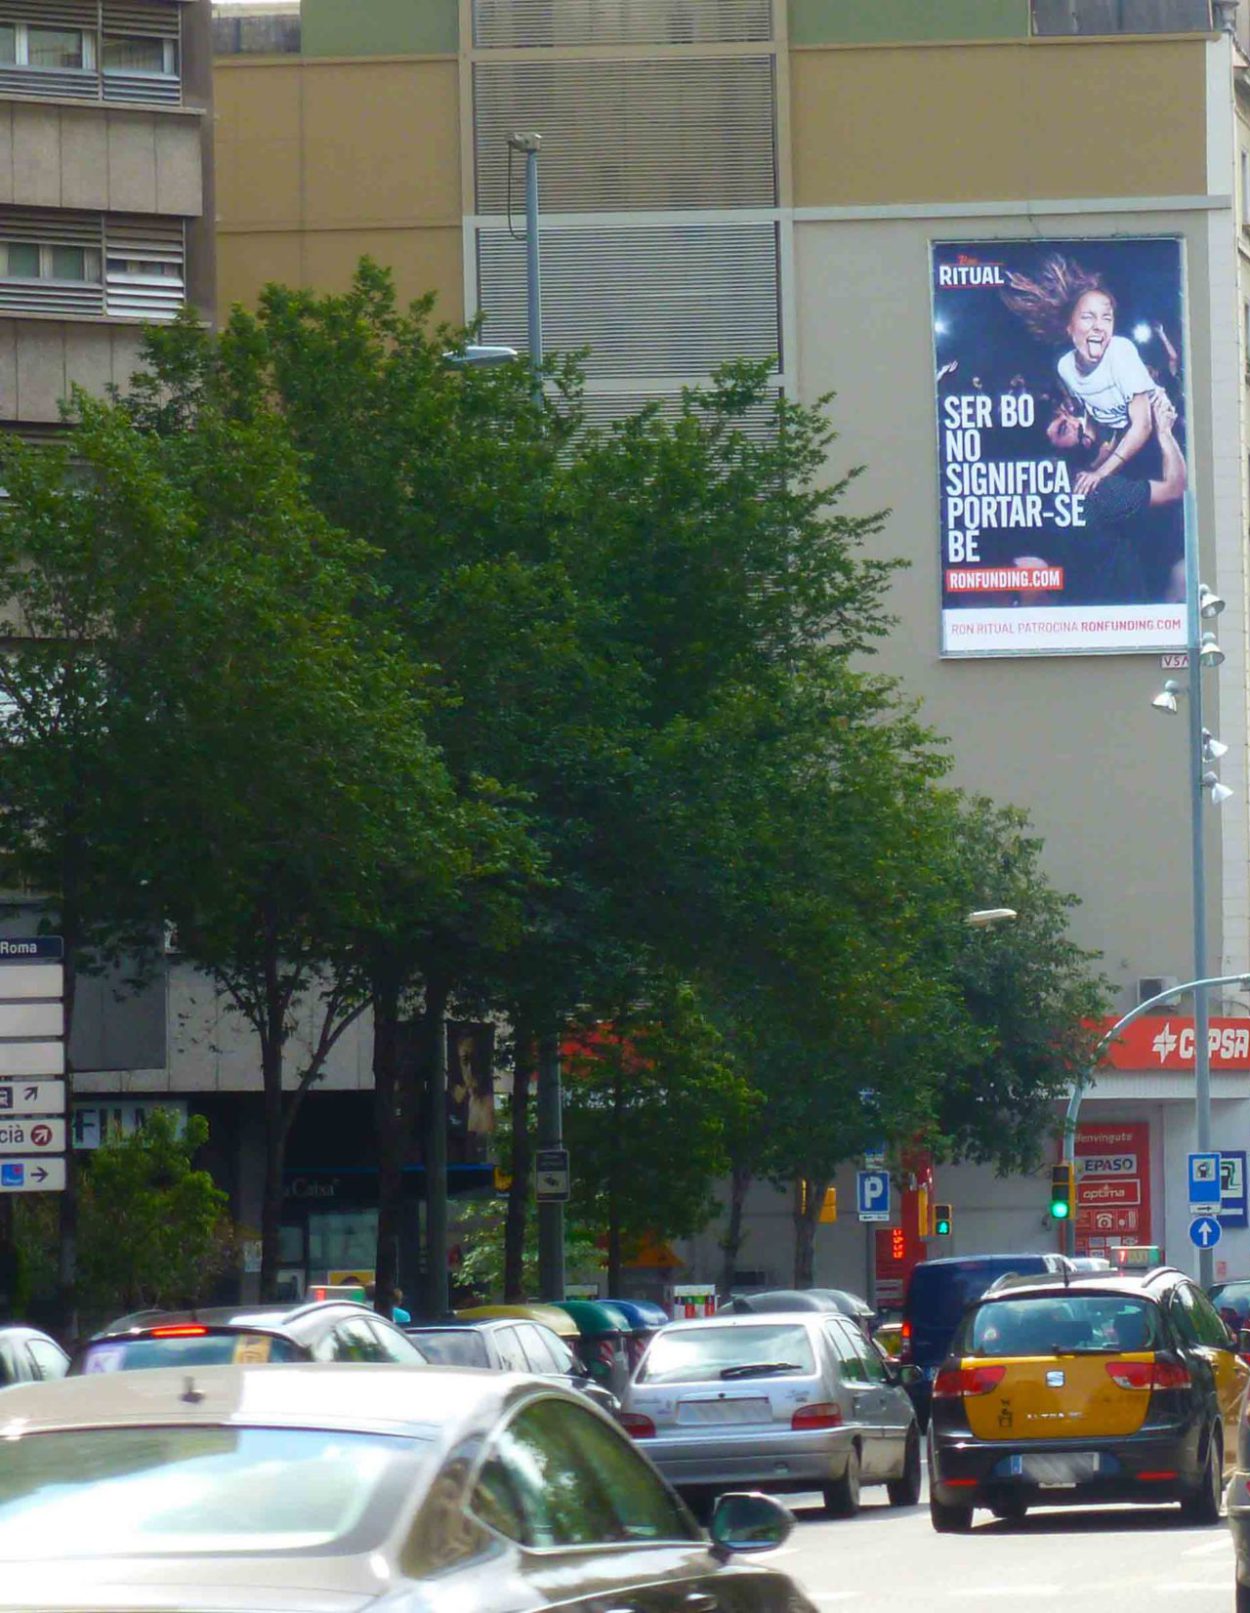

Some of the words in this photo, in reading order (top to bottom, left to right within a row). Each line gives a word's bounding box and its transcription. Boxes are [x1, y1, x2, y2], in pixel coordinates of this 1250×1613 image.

[939, 265, 1005, 286] RITUAL
[944, 395, 993, 429] SER
[1000, 393, 1035, 428] BO
[945, 429, 981, 462] NO
[945, 460, 1071, 496] SIGNIFICA
[947, 494, 1086, 530] PORTAR-SE
[950, 570, 1060, 589] RONFUNDING.COM
[951, 624, 974, 635] RON
[976, 622, 1014, 634] RITUAL
[1017, 621, 1078, 633] PATROCINA
[1081, 619, 1181, 632] RONFUNDING.COM
[0, 941, 37, 954] Roma
[1179, 1028, 1250, 1059] CPSA
[864, 1176, 883, 1209] P
